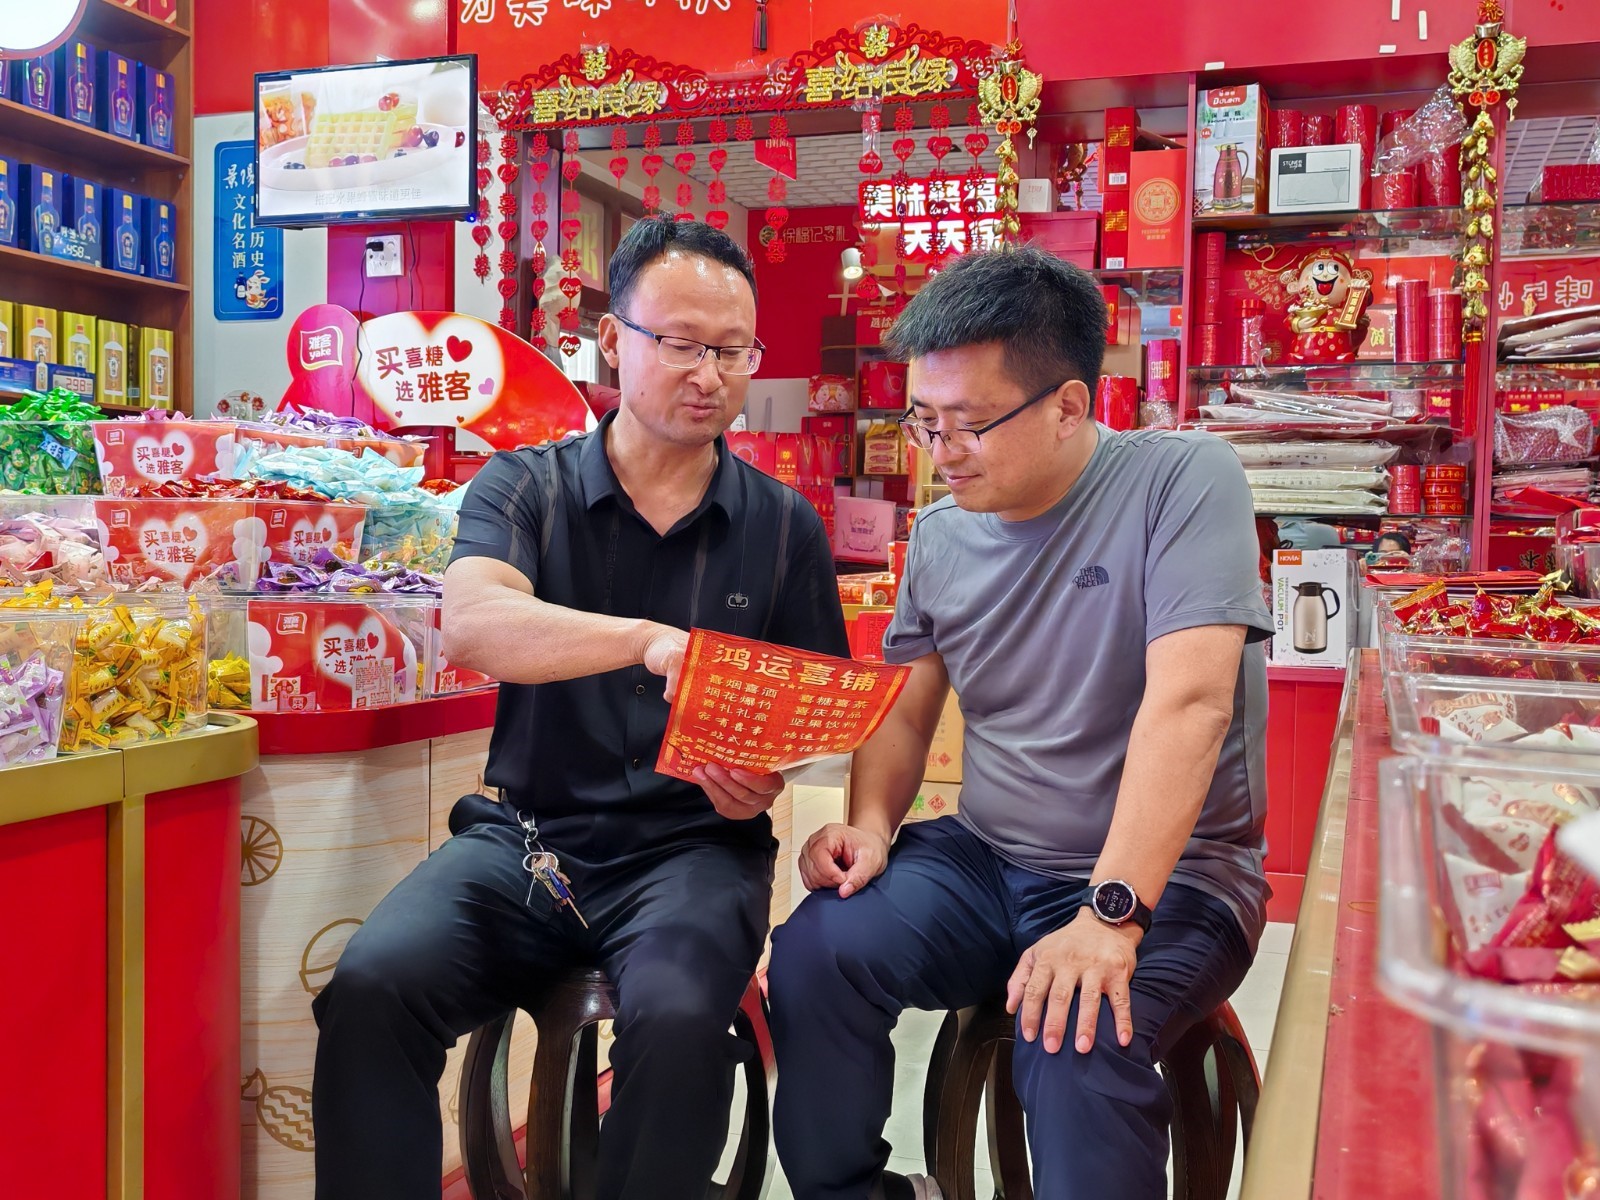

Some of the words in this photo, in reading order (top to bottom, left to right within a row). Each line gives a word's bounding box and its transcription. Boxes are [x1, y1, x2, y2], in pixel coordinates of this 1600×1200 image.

[803, 45, 951, 103] 喜结良缘
[532, 69, 662, 123] 喜结良缘
[232, 193, 246, 269] 文化名酒
[308, 333, 332, 349] 雅客
[309, 348, 332, 360] yake
[375, 345, 444, 379] 买喜糖
[66, 378, 86, 392] 298
[395, 370, 471, 403] 选雅客
[137, 446, 171, 463] 买喜糖
[146, 459, 184, 475] 选雅客
[144, 529, 183, 548] 买喜糖
[154, 545, 197, 563] 选雅客
[1080, 567, 1094, 576] THE
[323, 636, 367, 658] 买喜糖
[711, 643, 880, 692] 鸿运喜铺
[704, 685, 773, 710] 烟花爆竹
[795, 706, 862, 719] 喜庆用品
[708, 673, 779, 699] 喜烟喜酒
[799, 694, 870, 709] 喜糖喜茶
[698, 712, 764, 736] 家有喜事
[789, 717, 857, 729] 坚果饮料
